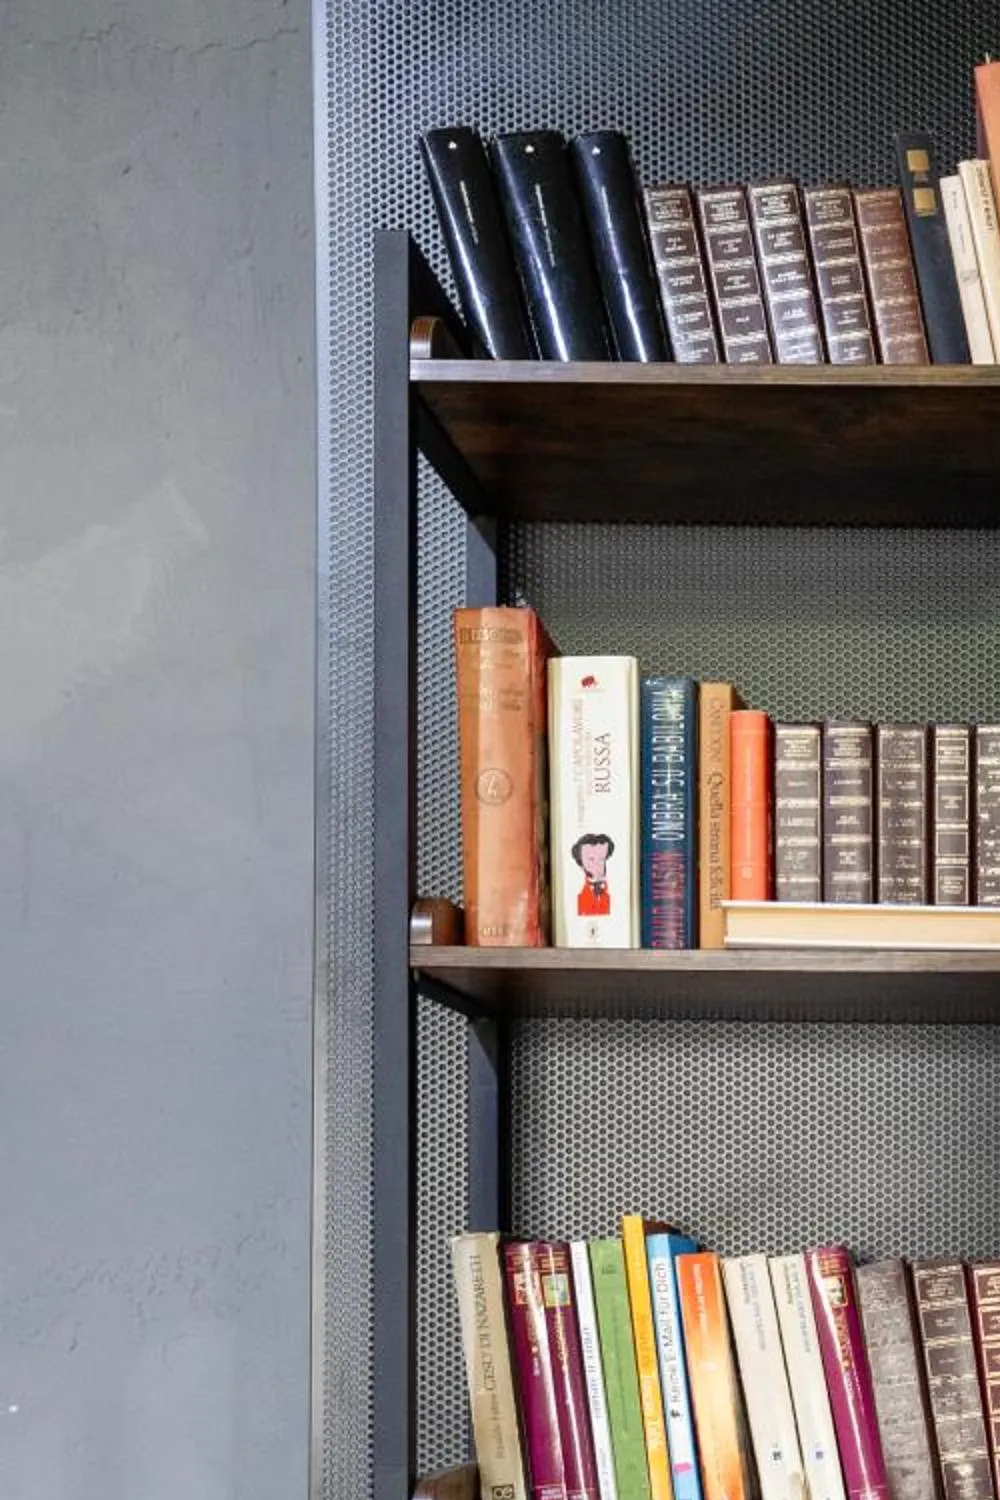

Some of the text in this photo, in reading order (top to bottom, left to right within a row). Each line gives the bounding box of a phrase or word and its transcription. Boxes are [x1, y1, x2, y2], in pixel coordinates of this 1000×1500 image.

[594, 732, 612, 794] RUSSA
[650, 690, 684, 841] OMBRA SU BABILONIA
[705, 772, 724, 819] Quella
